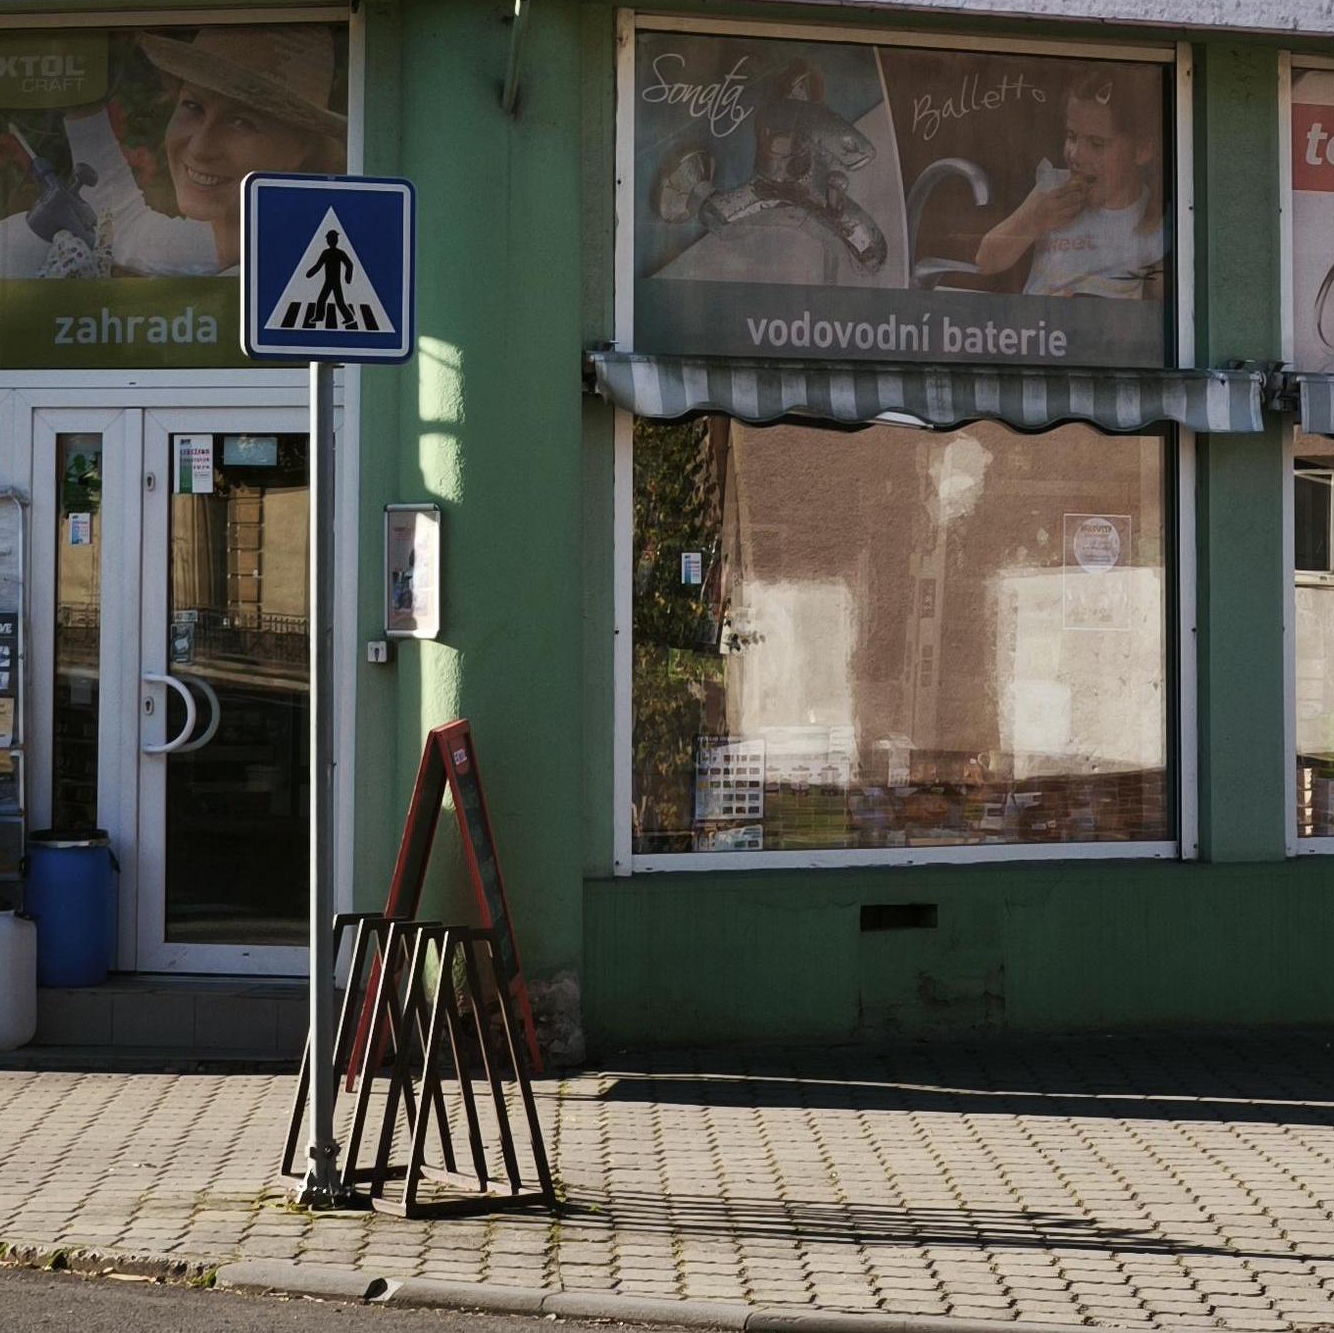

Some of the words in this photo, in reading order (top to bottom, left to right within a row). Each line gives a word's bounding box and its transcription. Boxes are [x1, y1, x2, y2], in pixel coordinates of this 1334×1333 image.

[21, 78, 85, 94] CRAFT
[912, 73, 1046, 141] Balletto
[54, 307, 218, 347] zahrada
[747, 311, 930, 353] vodovodní
[943, 316, 1067, 357] baterie
